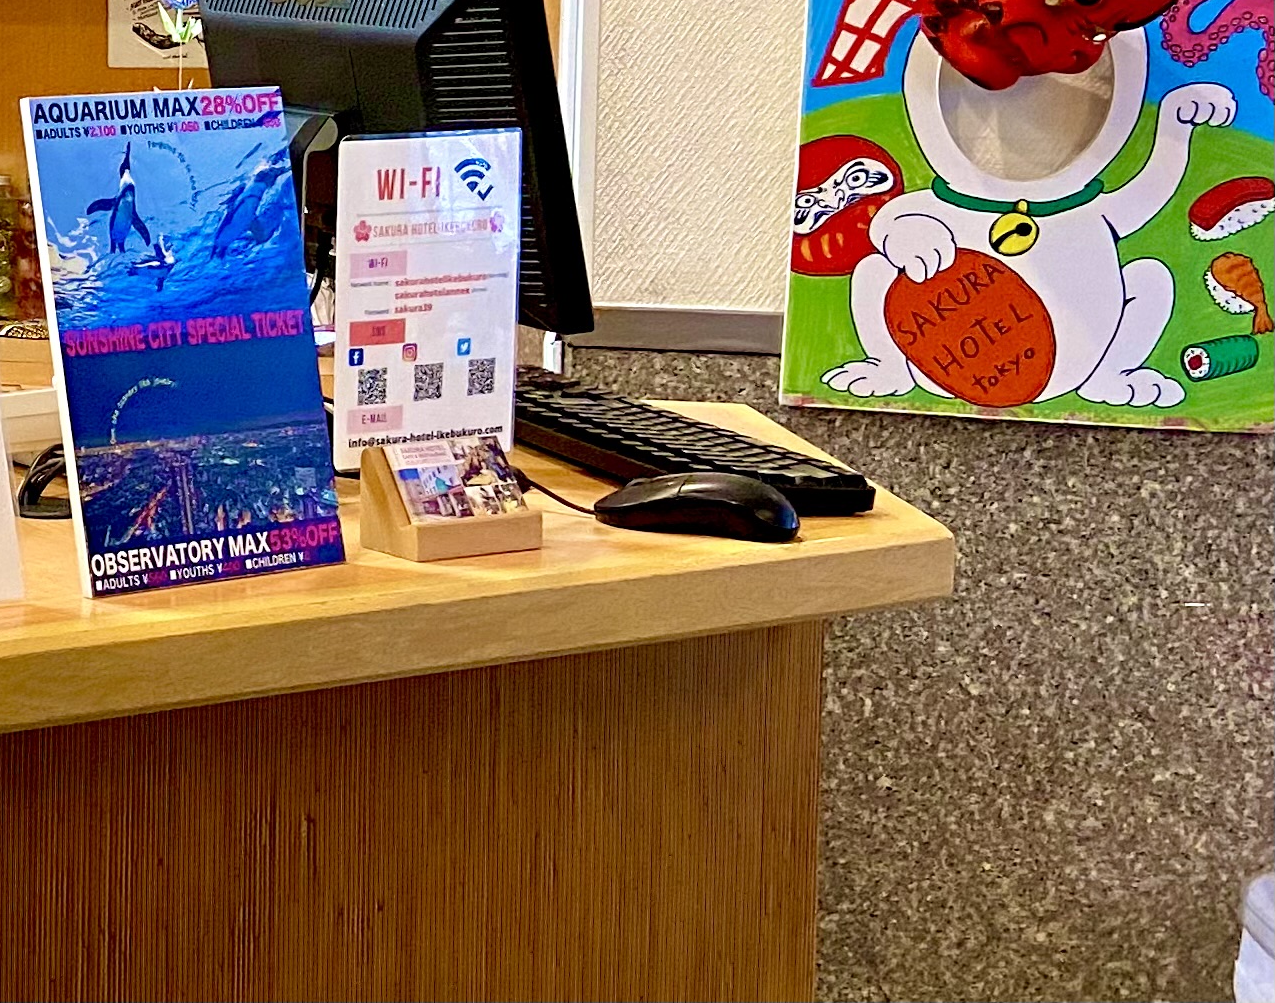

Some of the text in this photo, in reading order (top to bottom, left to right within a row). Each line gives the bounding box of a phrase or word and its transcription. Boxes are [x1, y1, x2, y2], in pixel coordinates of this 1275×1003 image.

[34, 98, 147, 124] AQUARIUM
[153, 96, 200, 118] MAX
[377, 166, 441, 201] WI-FI
[373, 224, 409, 238] SAKURA
[411, 222, 438, 235] HOTEL
[897, 261, 1005, 347] SAKURA
[65, 309, 304, 358] SUNSHINE CITY SPECIAL TICKET
[933, 302, 1034, 377] HOTEL
[91, 537, 225, 577] OBSERVATORY
[228, 531, 271, 557] MAX
